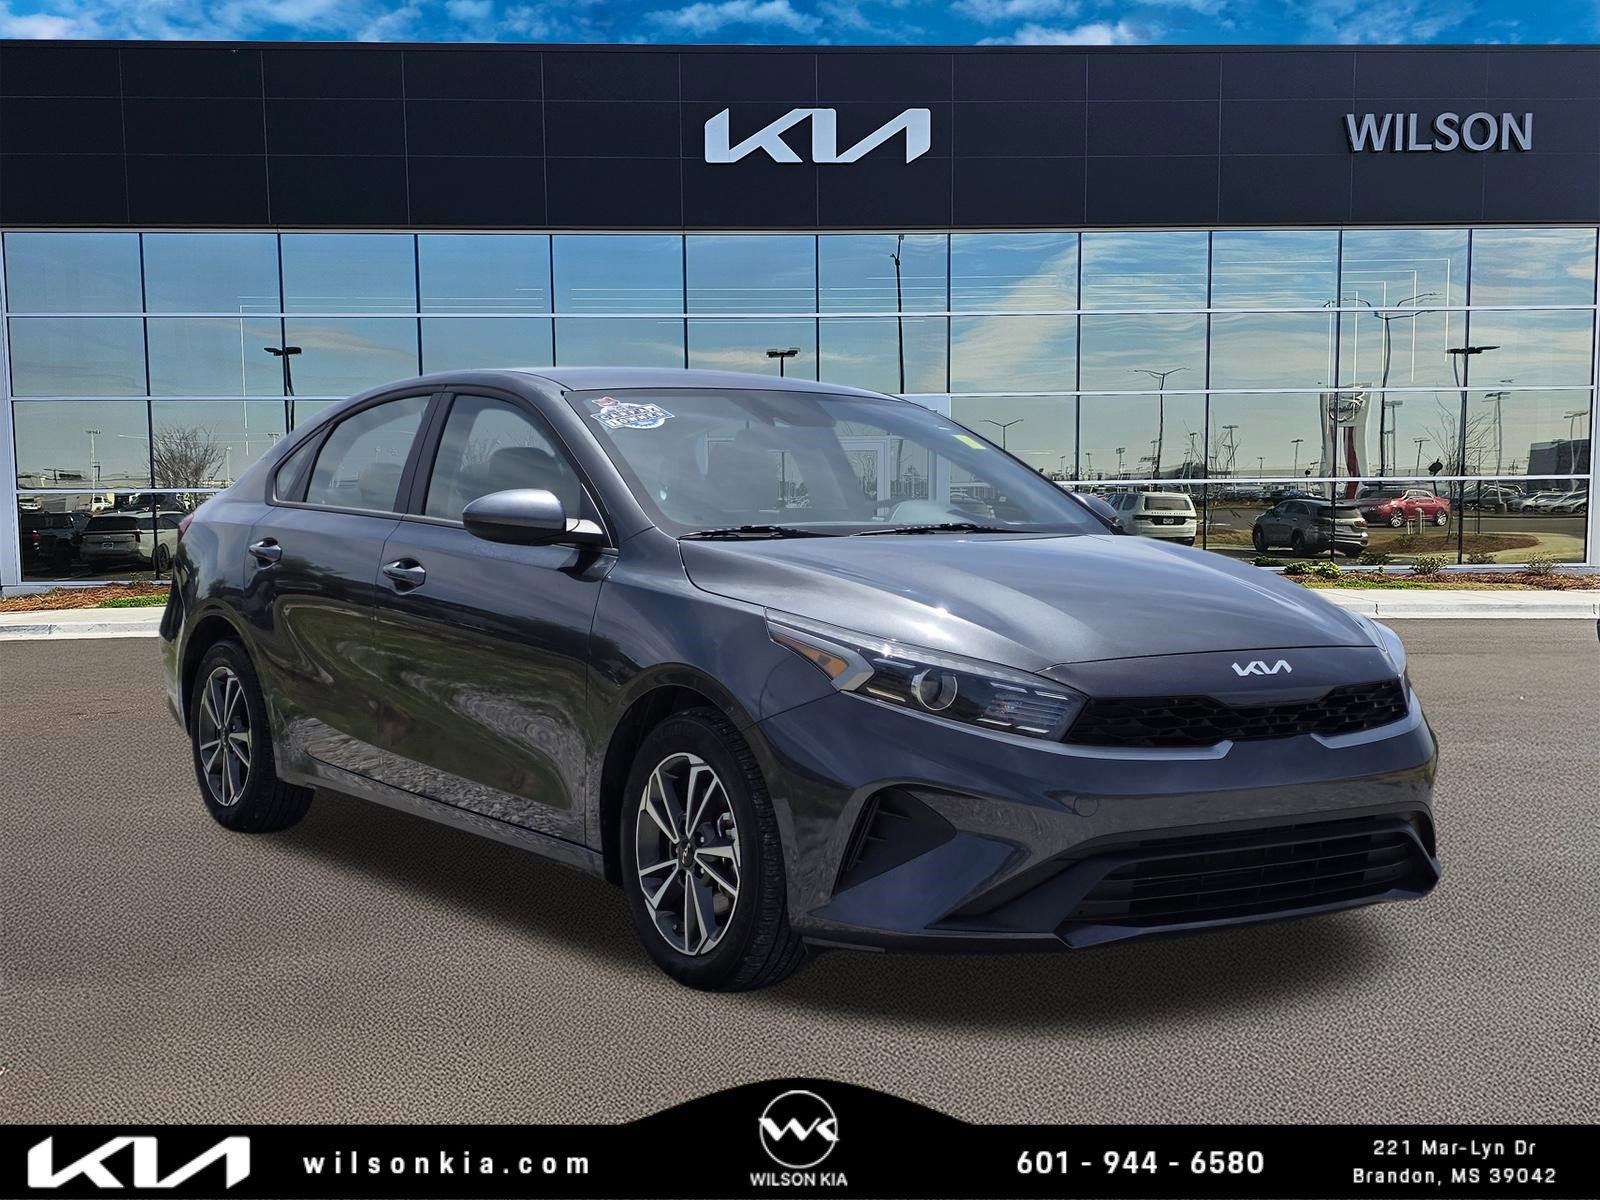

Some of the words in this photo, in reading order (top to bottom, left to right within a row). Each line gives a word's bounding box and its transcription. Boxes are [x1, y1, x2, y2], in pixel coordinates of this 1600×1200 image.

[704, 107, 931, 164] KIA
[1345, 112, 1534, 152] WILSON
[1231, 659, 1293, 677] KIA
